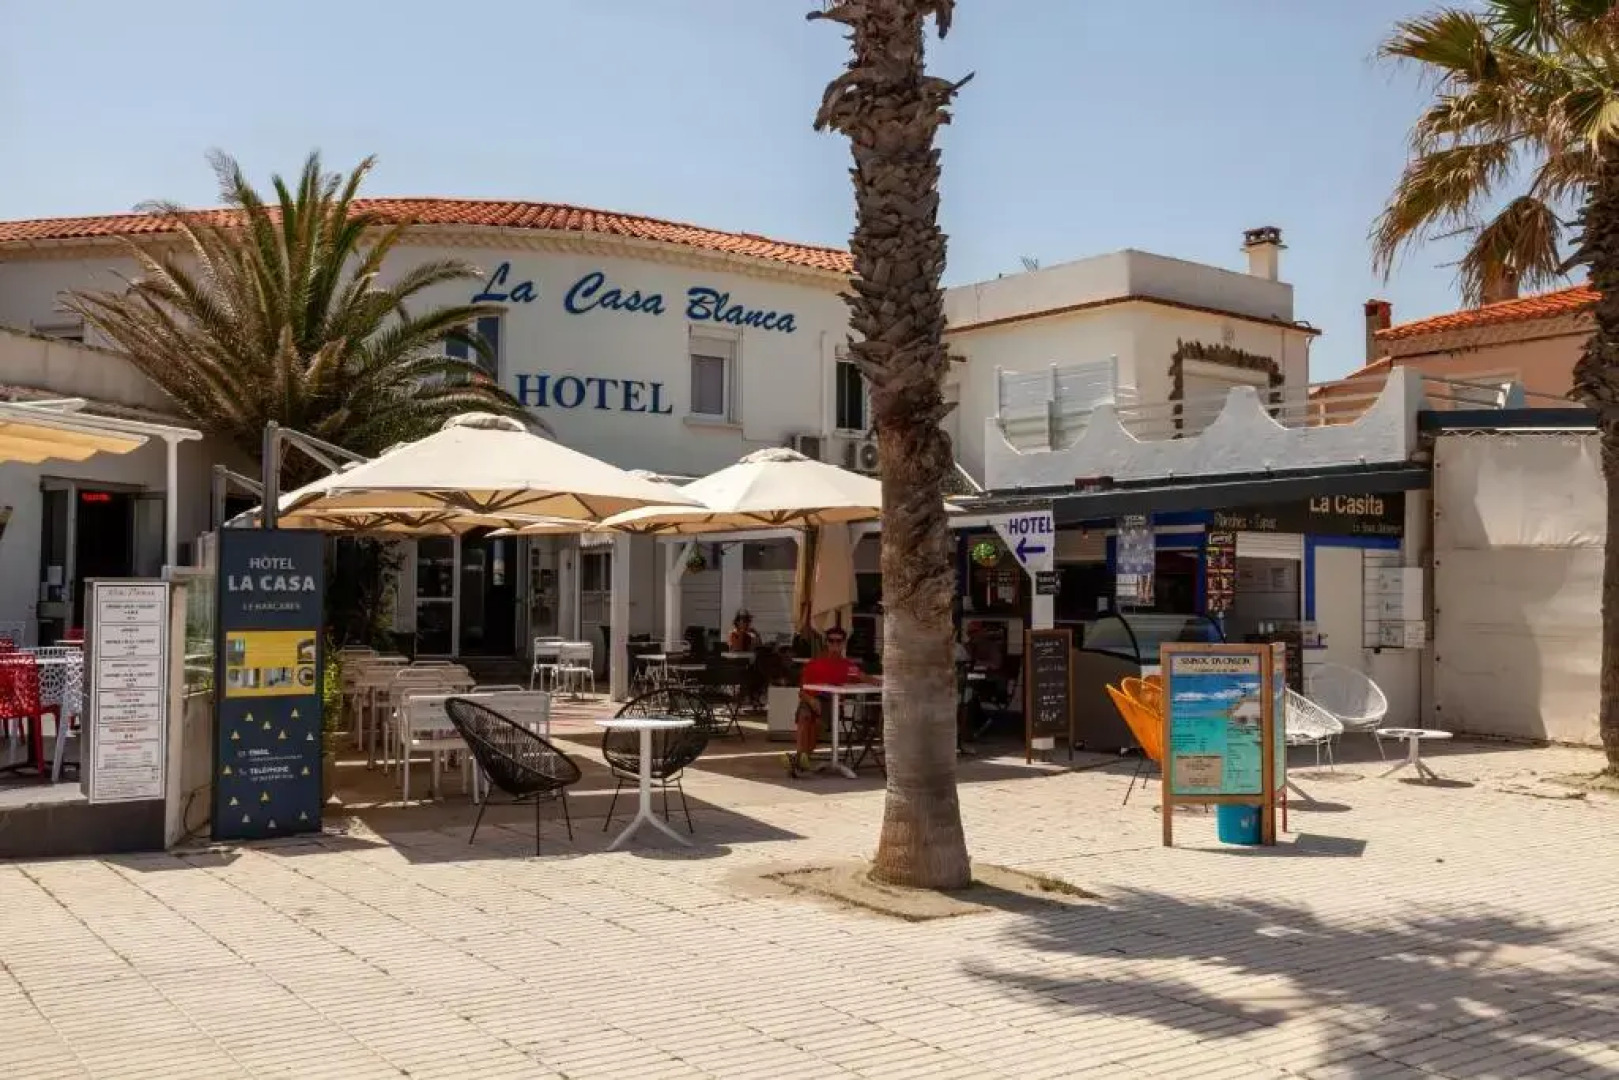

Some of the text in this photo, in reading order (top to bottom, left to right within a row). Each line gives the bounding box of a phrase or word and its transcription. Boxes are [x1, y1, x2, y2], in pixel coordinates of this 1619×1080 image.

[470, 261, 798, 334] La Casa Blanca
[515, 374, 673, 414] HOTEL
[1309, 493, 1384, 516] La Casita
[1009, 515, 1054, 535] HOTEL
[228, 574, 316, 592] LA CASA
